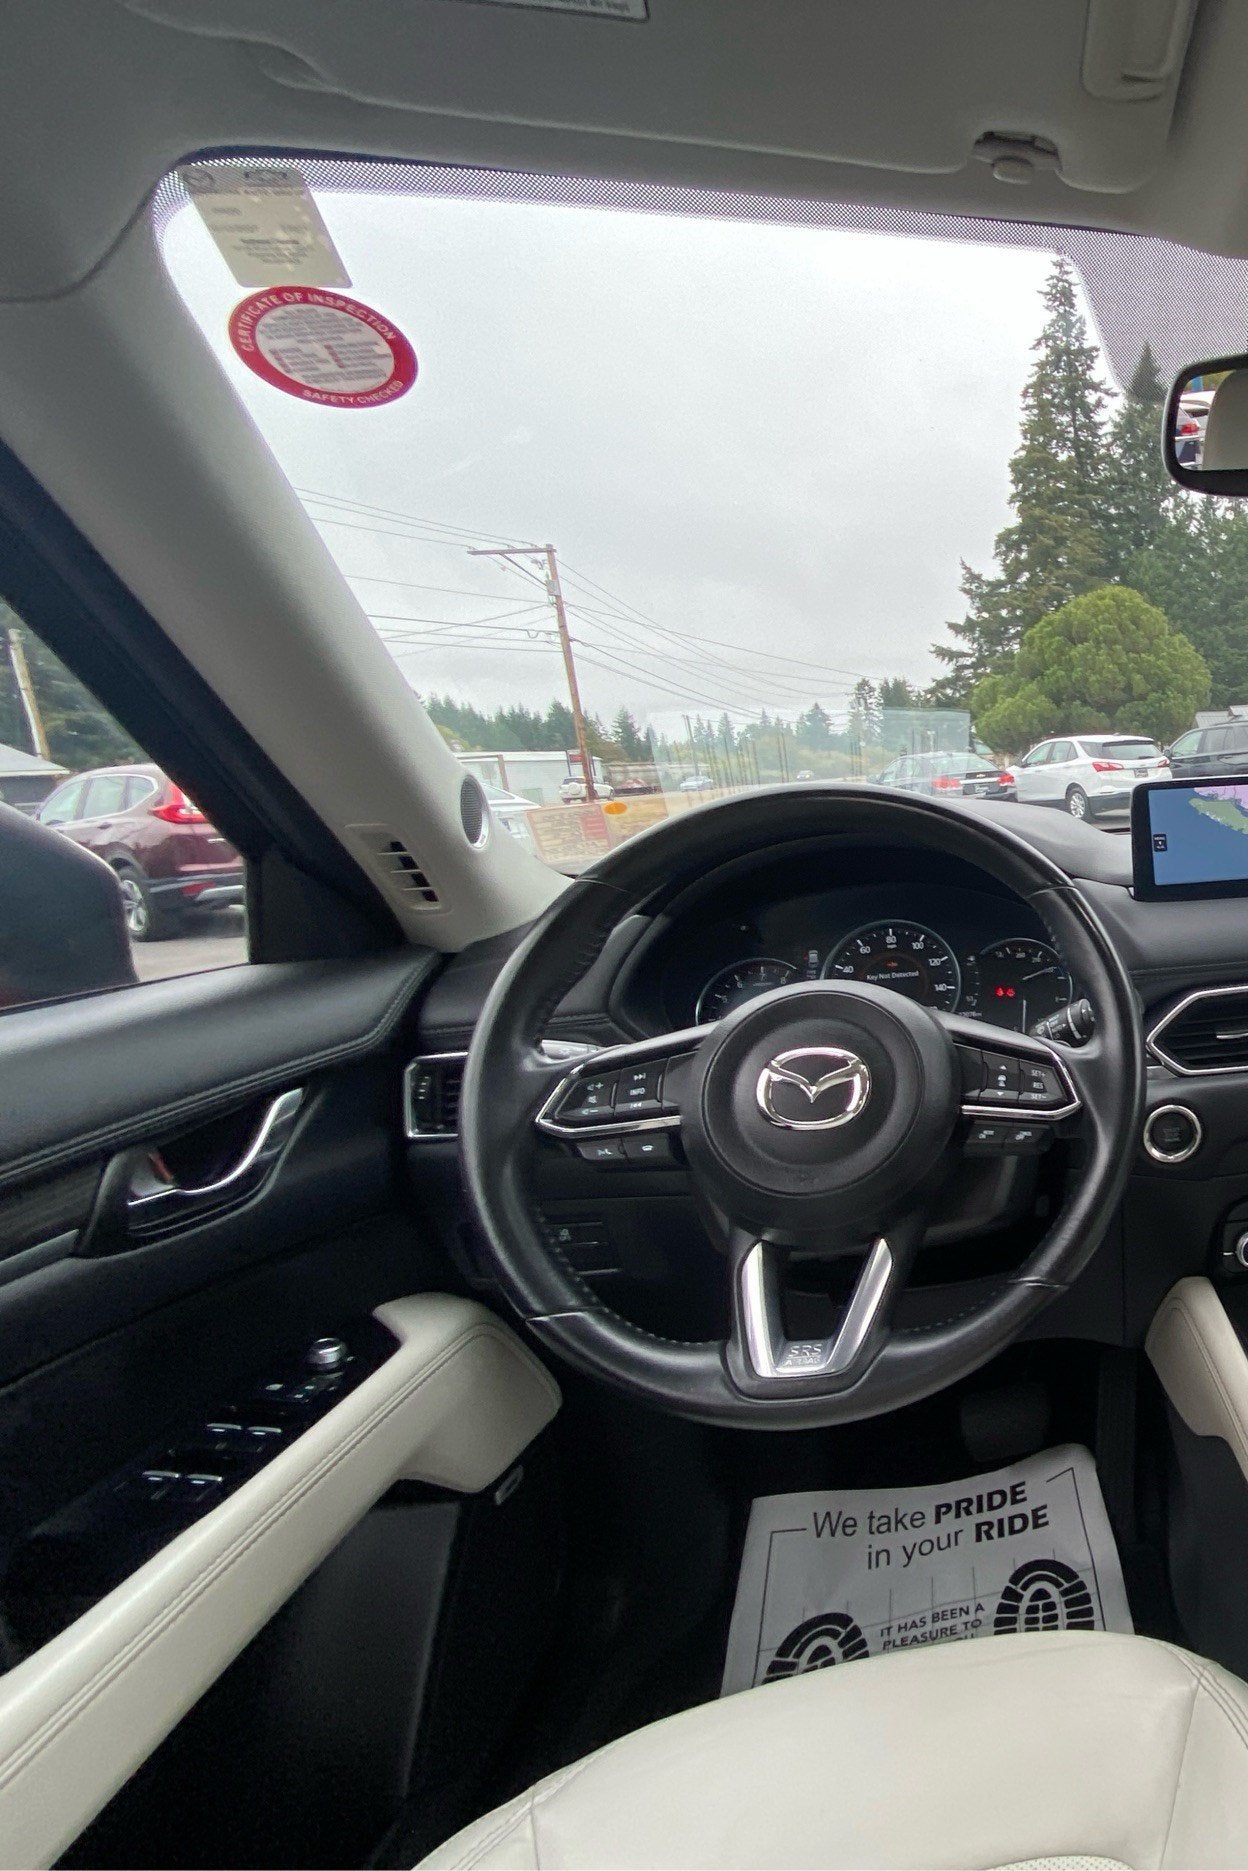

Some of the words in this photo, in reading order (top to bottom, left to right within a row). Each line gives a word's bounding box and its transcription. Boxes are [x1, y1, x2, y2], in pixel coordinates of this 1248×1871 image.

[237, 295, 282, 351] CERTIFICATE
[283, 292, 303, 302] OF
[307, 293, 397, 340] INSPECTION
[301, 389, 355, 404] SAFETY
[358, 380, 404, 404] CHECKED
[859, 946, 871, 954] 60
[911, 941, 925, 950] 100
[842, 965, 854, 974] 40
[789, 1343, 822, 1357] SRS
[813, 1510, 858, 1539] We
[867, 1508, 925, 1536] take
[934, 1481, 1028, 1525] PRIDE
[867, 1545, 890, 1570] in
[902, 1527, 964, 1568] your
[975, 1504, 1050, 1544] RIDE
[880, 1626, 893, 1637] IT
[897, 1616, 927, 1633] HAS
[932, 1605, 970, 1623] BEEN
[975, 1603, 985, 1613] A
[883, 1624, 958, 1651] PLEASURE
[962, 1618, 982, 1631] TO
